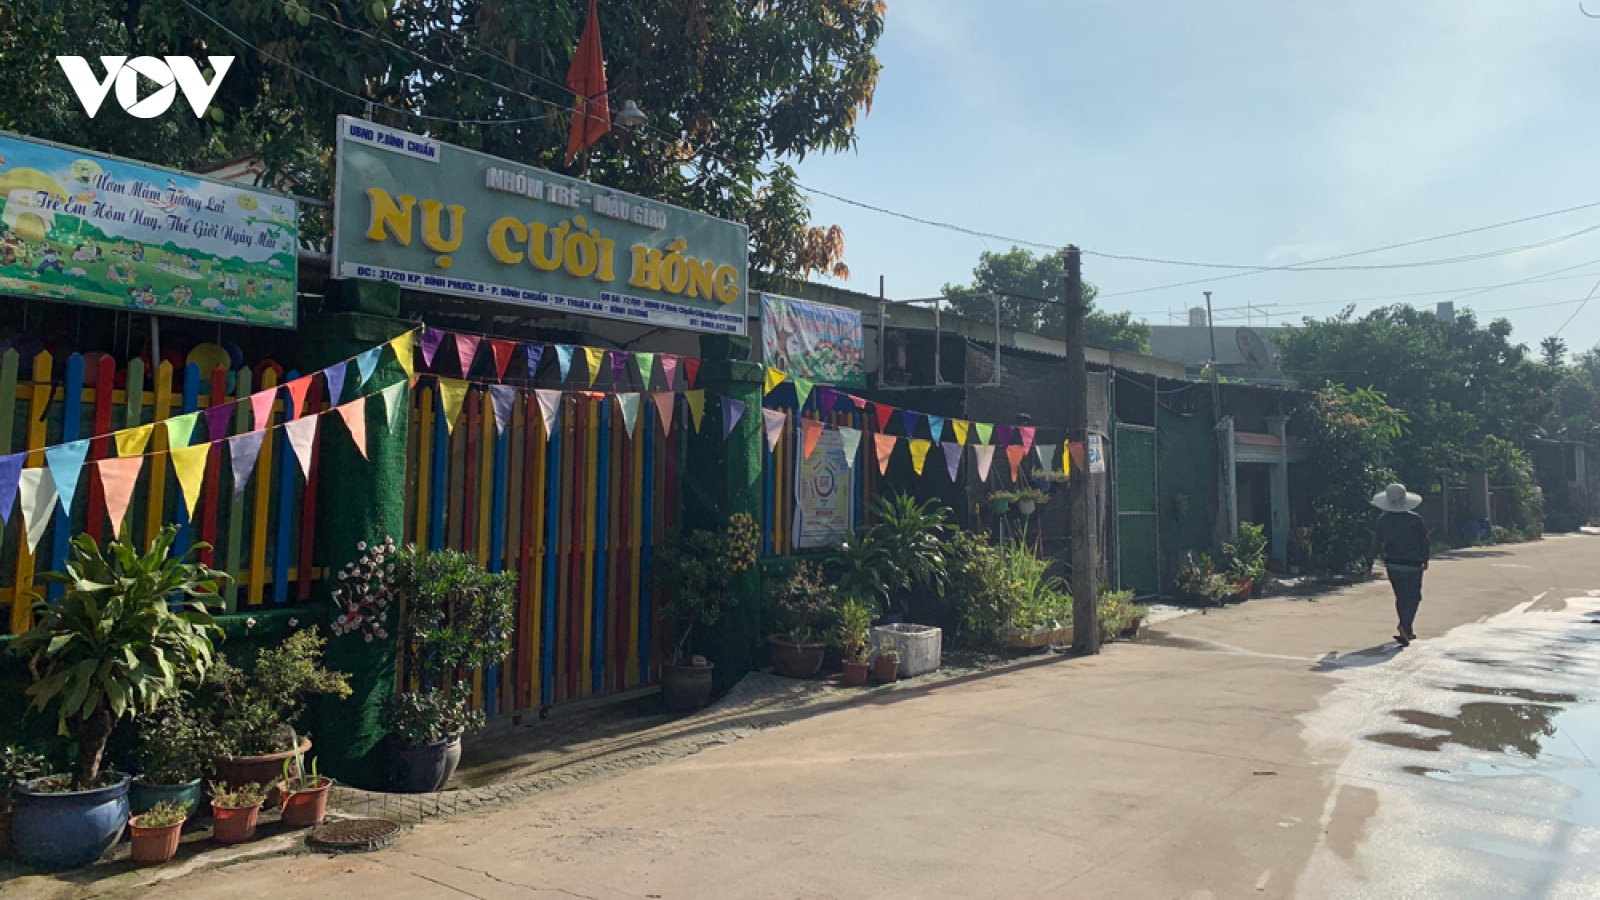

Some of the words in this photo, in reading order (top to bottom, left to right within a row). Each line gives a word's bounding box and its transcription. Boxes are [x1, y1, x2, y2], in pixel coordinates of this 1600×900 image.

[349, 124, 374, 140] UBND
[486, 166, 544, 199] NHÓM
[545, 182, 580, 208] TRẺ
[63, 198, 88, 216] Em
[204, 195, 227, 215] Lai
[365, 188, 467, 269] NỤ
[486, 215, 615, 282] CƯỜI
[629, 236, 741, 304] HỒNG
[379, 269, 406, 282] 31/20
